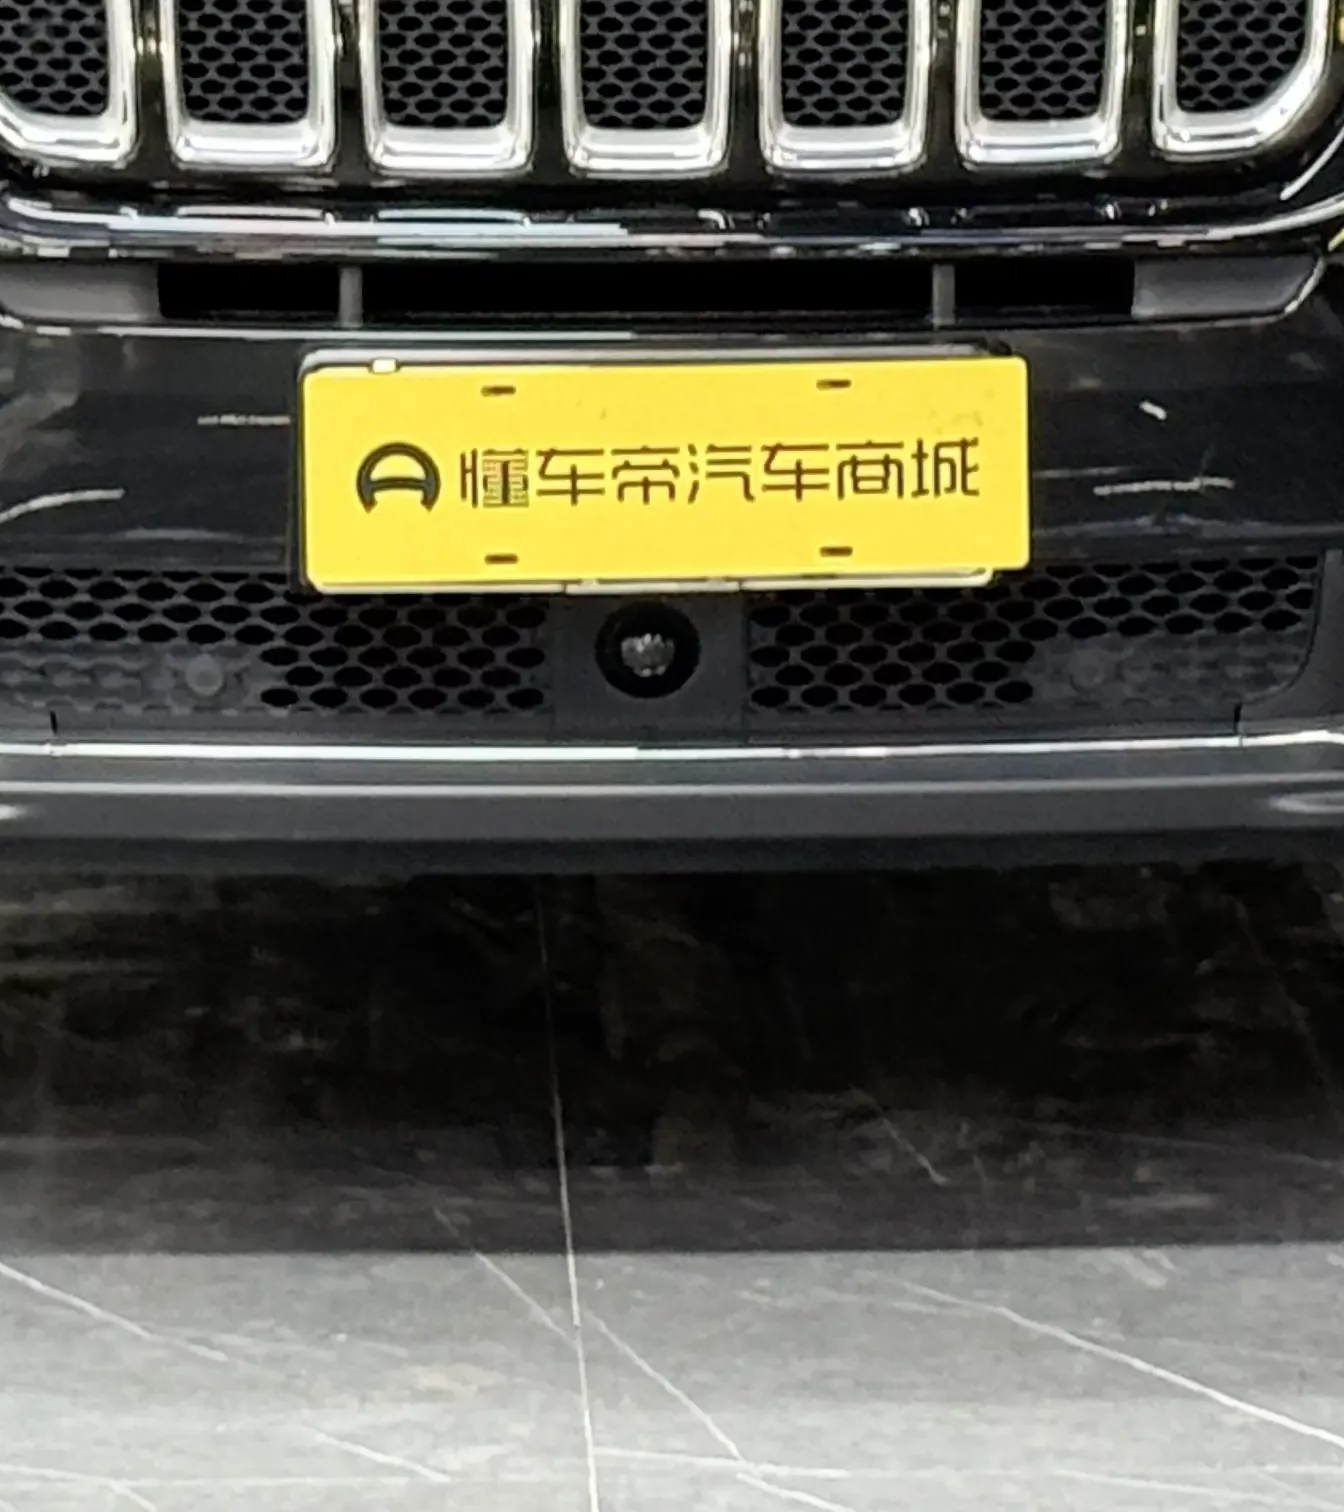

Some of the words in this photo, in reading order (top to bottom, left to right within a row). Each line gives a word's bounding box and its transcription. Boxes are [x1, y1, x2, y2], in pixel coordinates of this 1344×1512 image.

[459, 437, 980, 509] 懂车帝汽车商城
